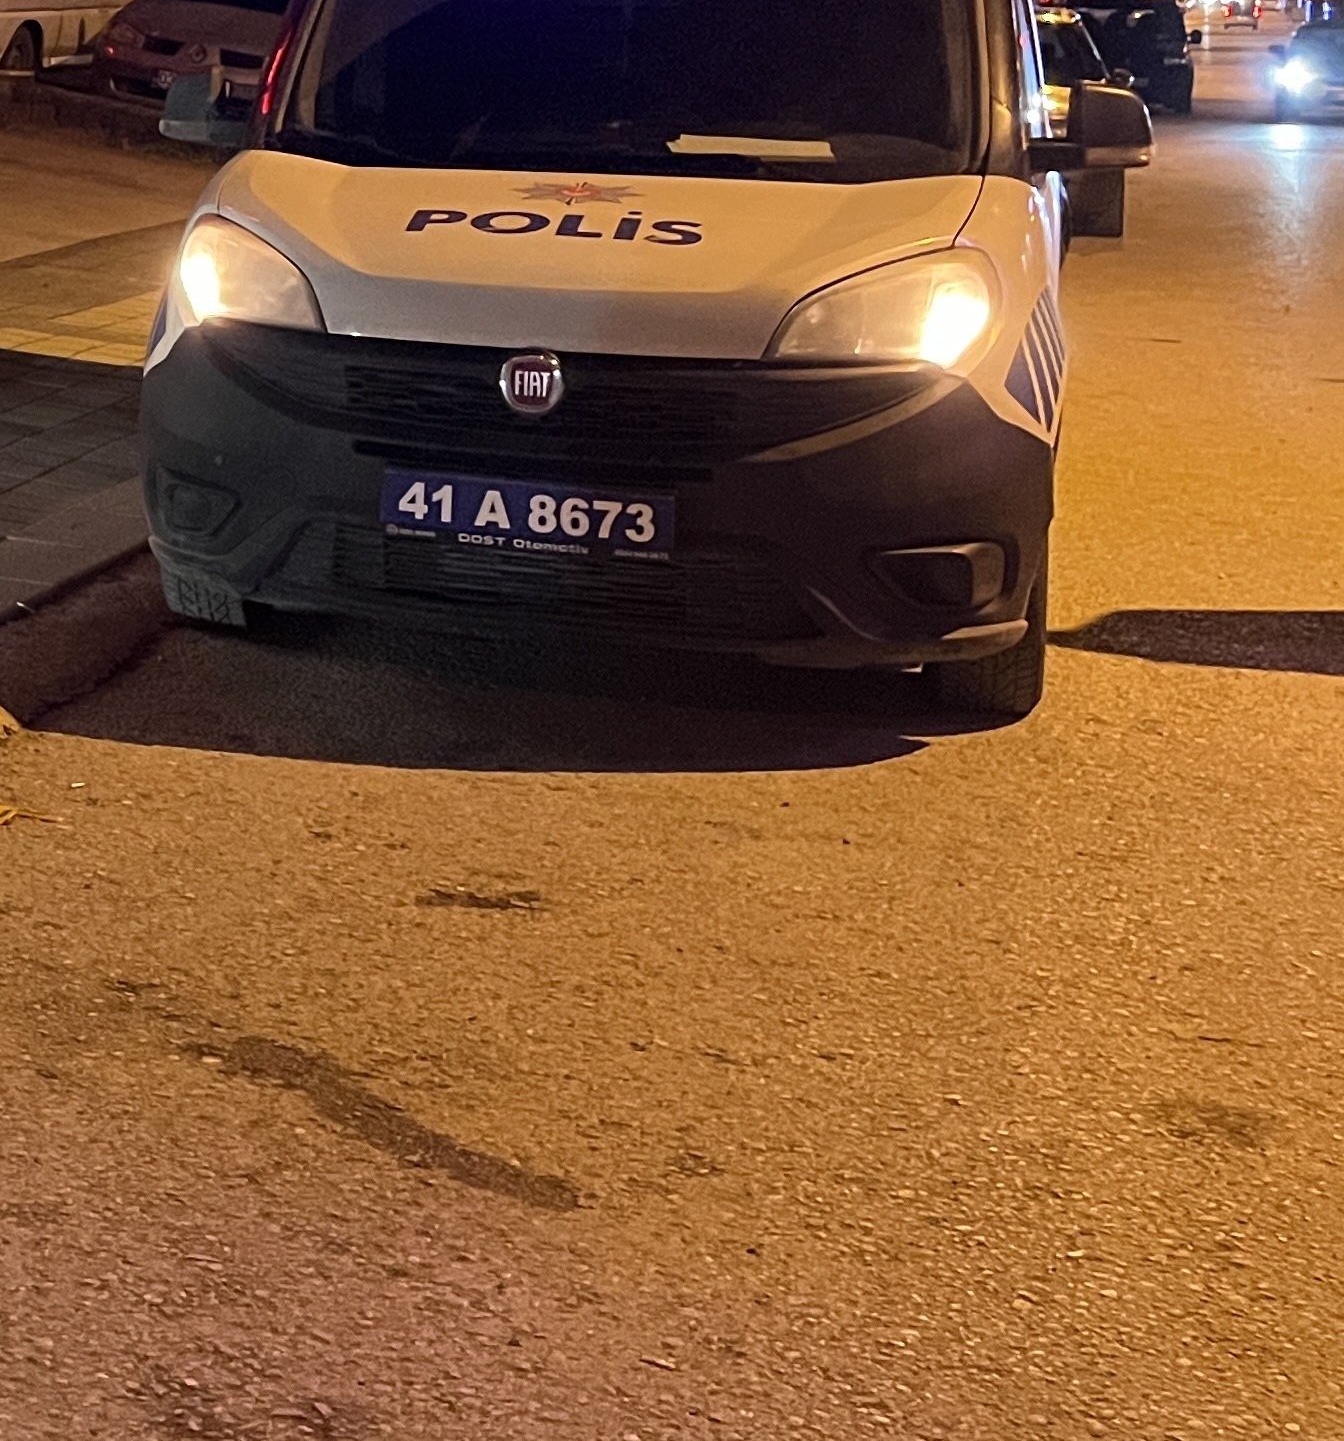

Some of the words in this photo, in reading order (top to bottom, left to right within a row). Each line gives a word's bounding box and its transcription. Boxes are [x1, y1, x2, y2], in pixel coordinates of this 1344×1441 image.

[405, 209, 702, 246] POLİS
[514, 370, 550, 398] FIAT
[398, 481, 453, 524] 41
[474, 490, 511, 530] A
[528, 494, 656, 543] 8673
[458, 533, 505, 547] DOST
